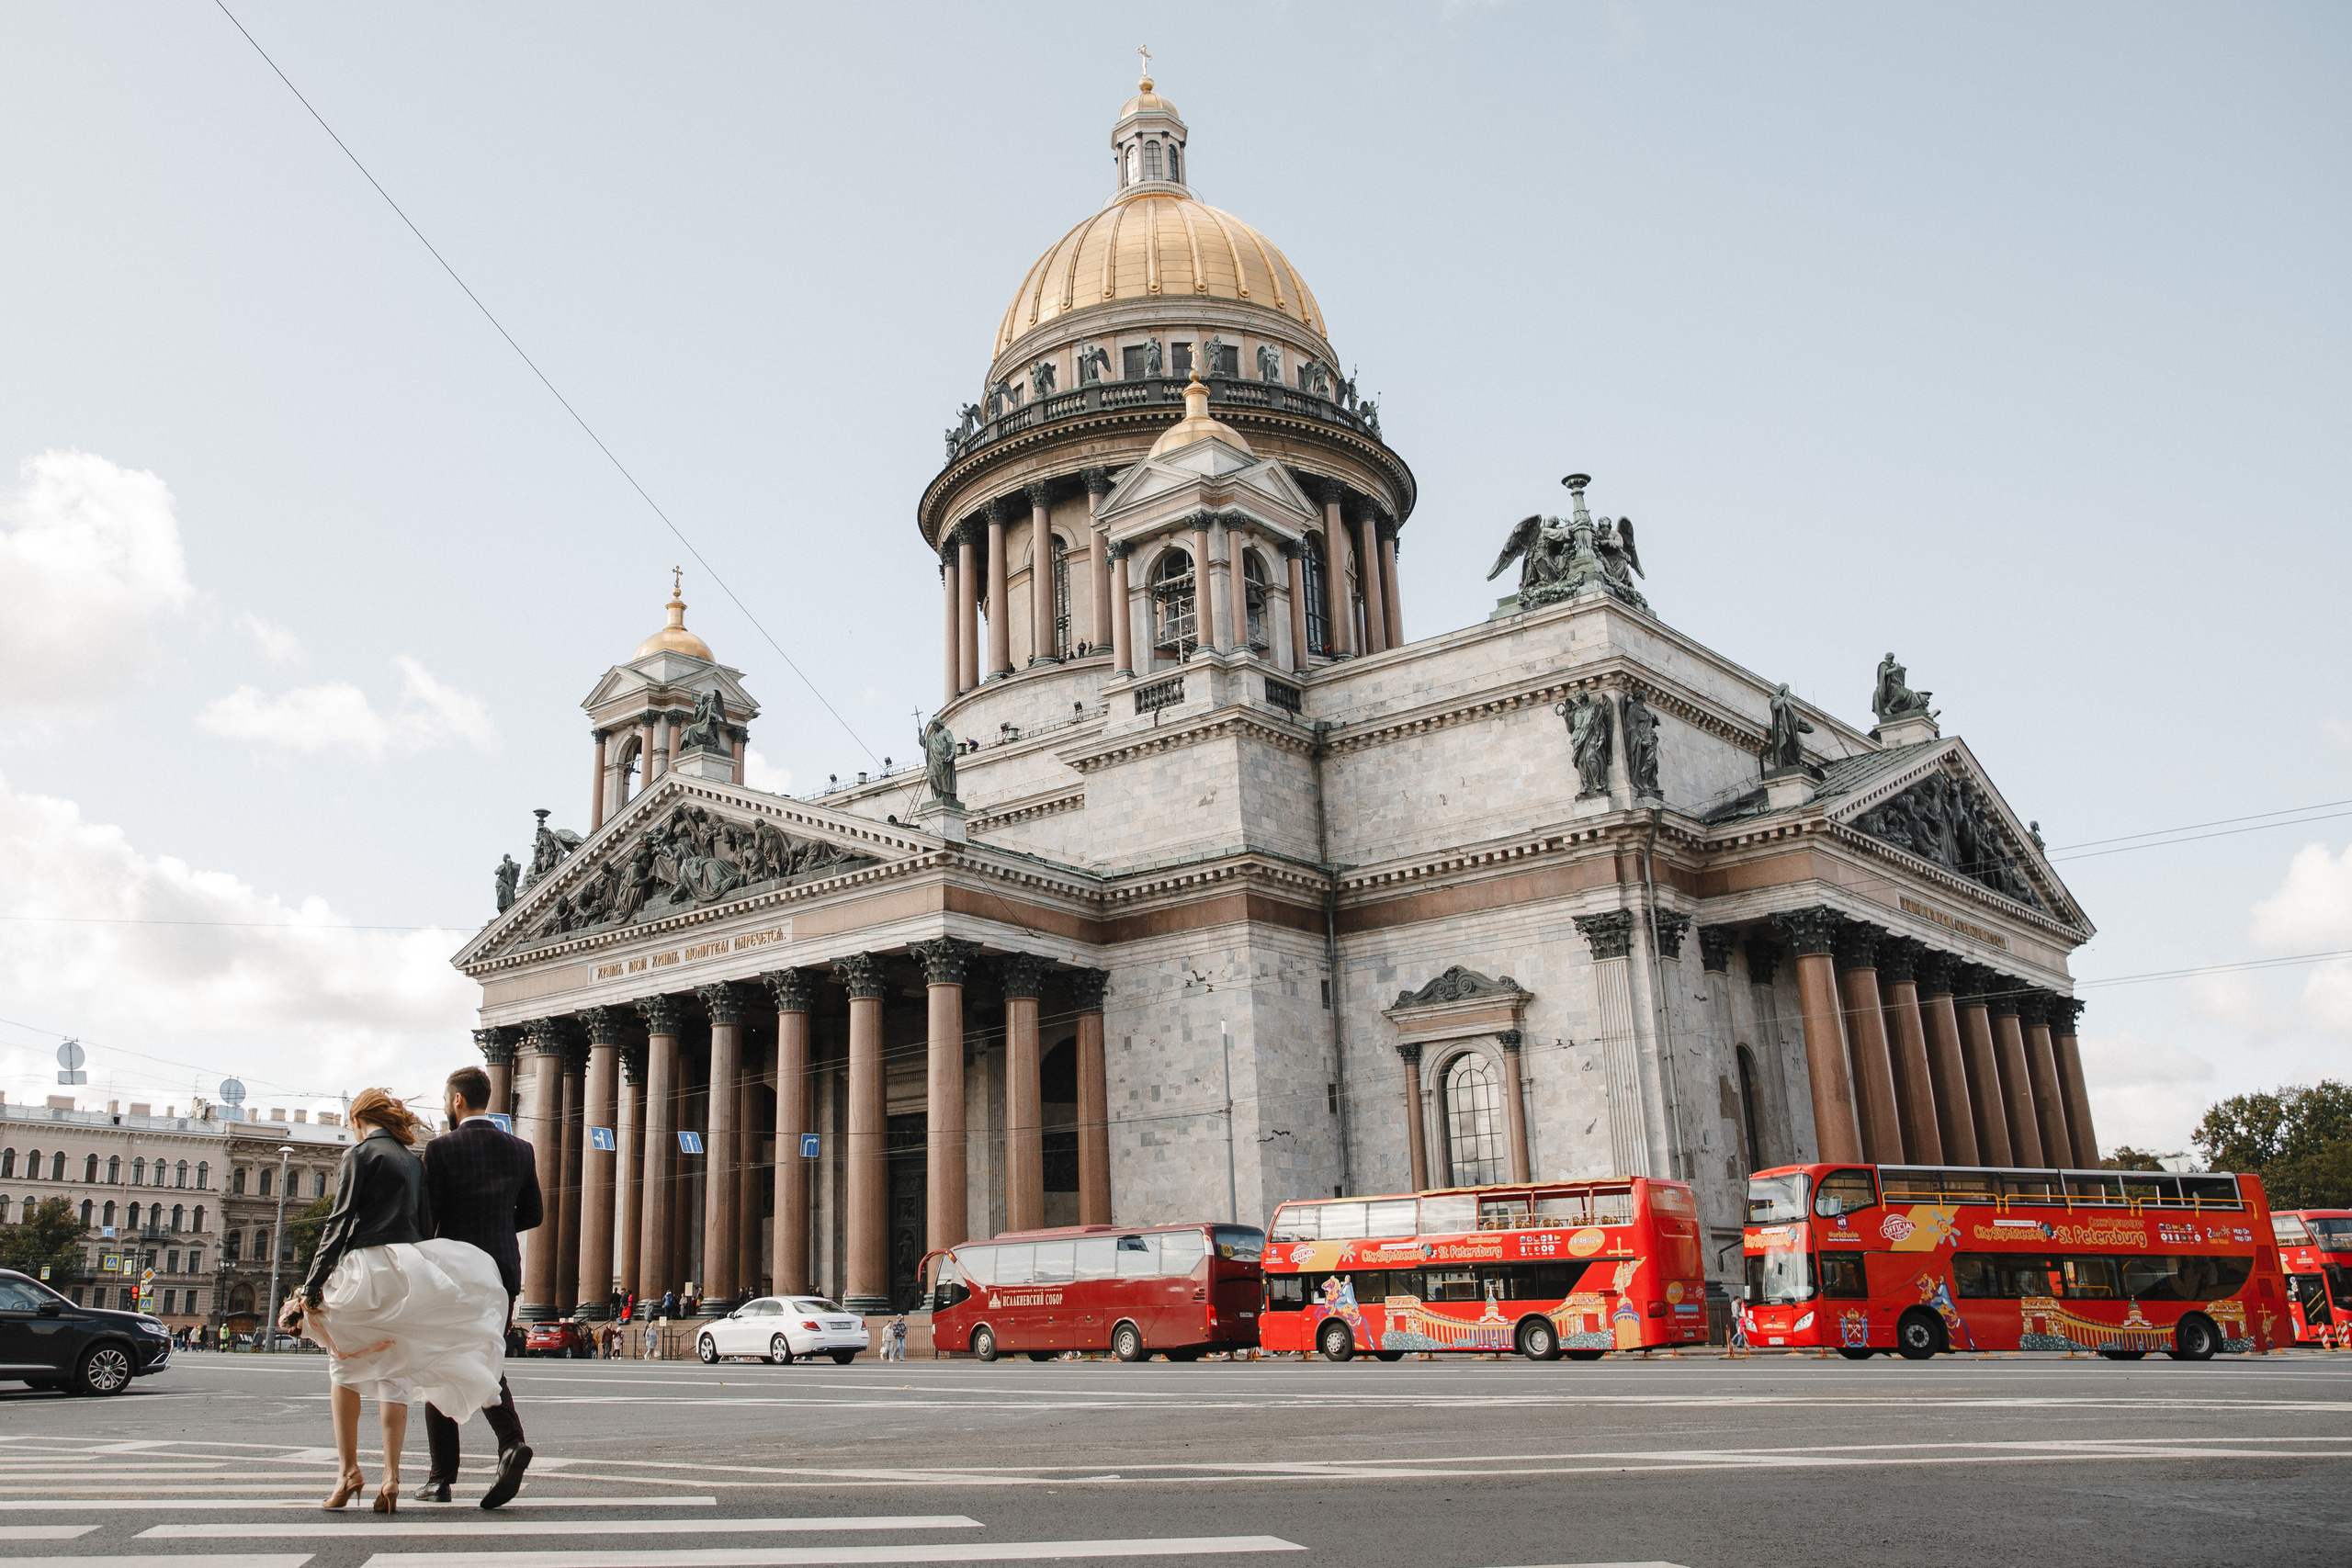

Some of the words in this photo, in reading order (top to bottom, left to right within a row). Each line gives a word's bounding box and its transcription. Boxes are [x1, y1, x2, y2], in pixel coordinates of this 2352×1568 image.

[1883, 1222, 1915, 1235] OFFICIAL
[2207, 1227, 2213, 1238] 2
[2056, 1224, 2074, 1244] St
[2073, 1224, 2148, 1248] Petersburg
[1438, 1246, 1449, 1258] St
[1450, 1245, 1502, 1258] Petersburg
[1002, 1292, 1044, 1306] ИСААКИЕВСКИЙ
[1045, 1293, 1063, 1304] СОБОР
